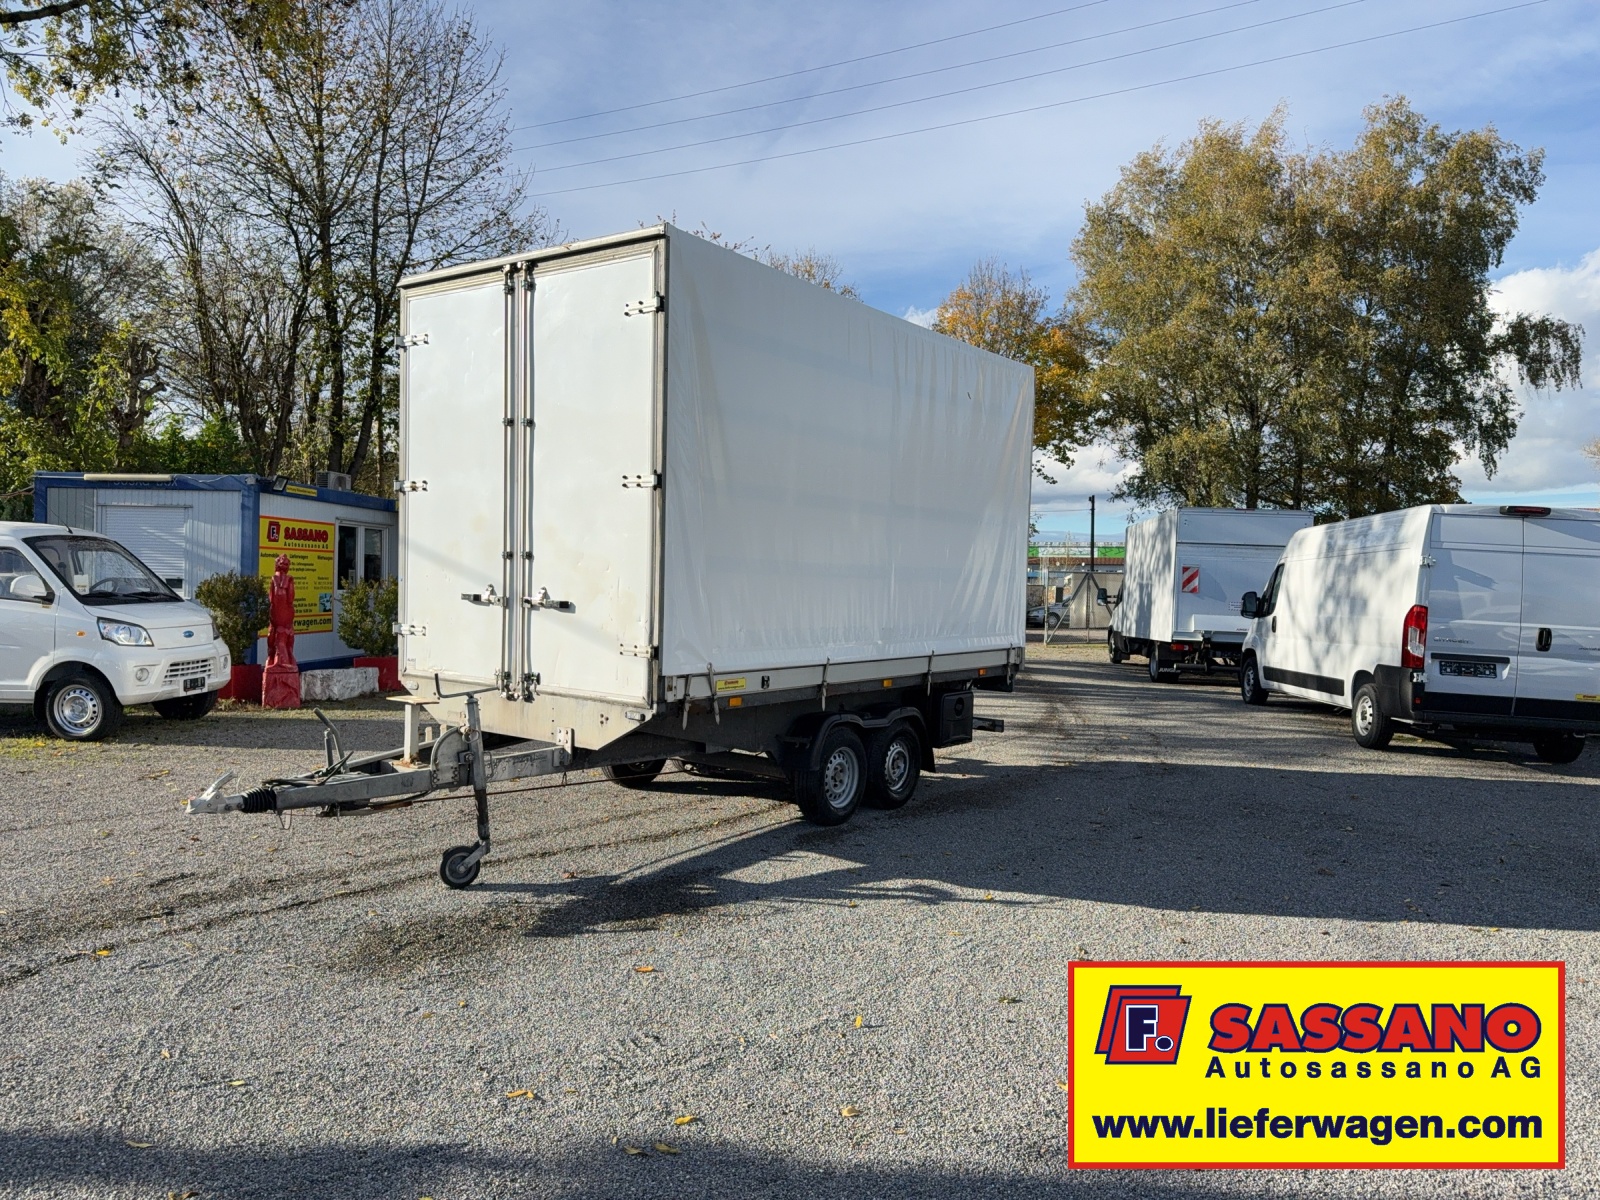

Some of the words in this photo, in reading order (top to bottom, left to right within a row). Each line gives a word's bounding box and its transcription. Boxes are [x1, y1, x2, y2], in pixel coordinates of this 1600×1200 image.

[284, 526, 329, 543] SASSANO
[284, 541, 320, 549] Autosassano
[294, 618, 332, 628] rwagen.com
